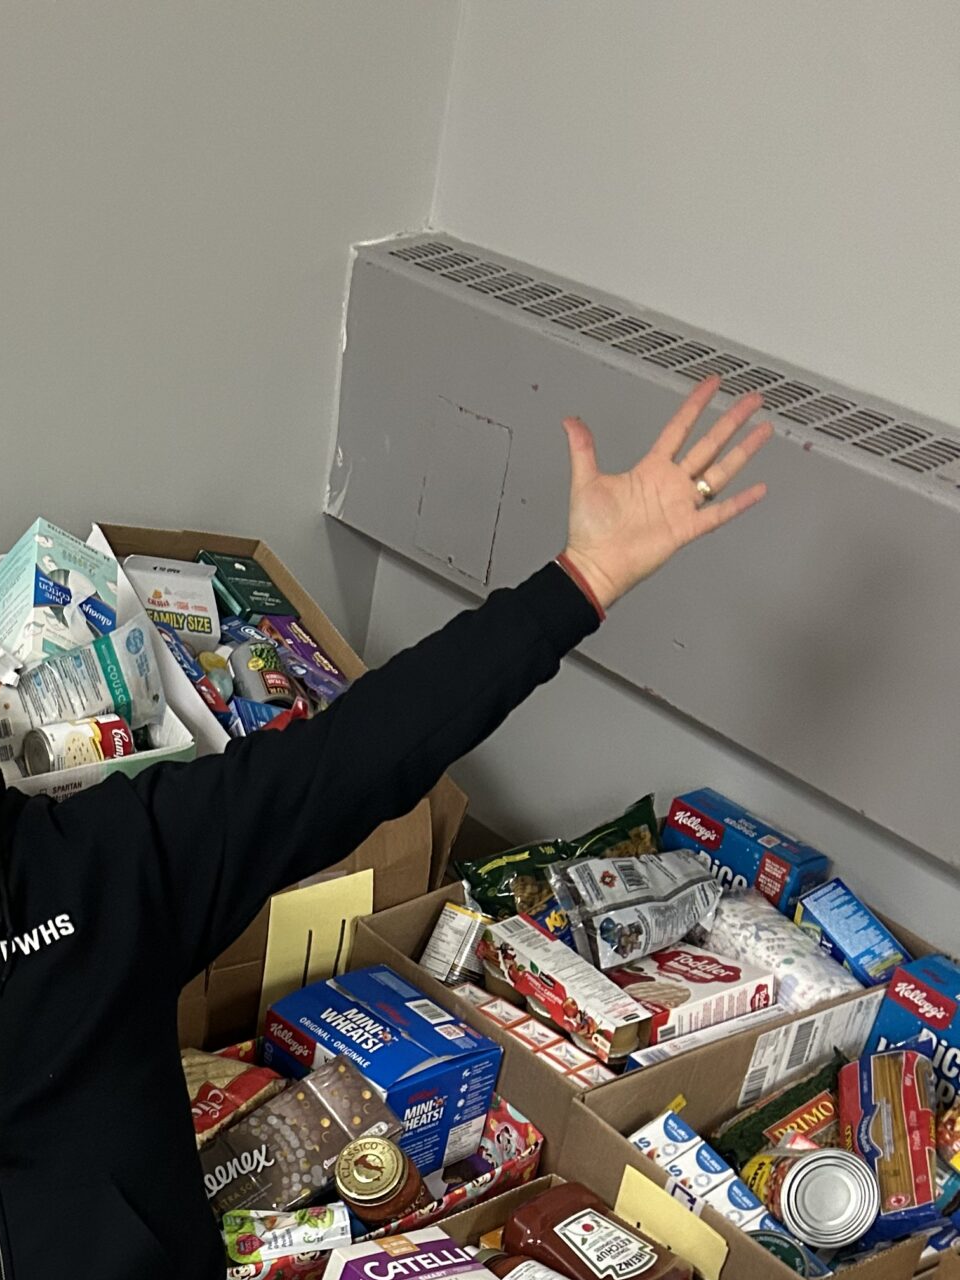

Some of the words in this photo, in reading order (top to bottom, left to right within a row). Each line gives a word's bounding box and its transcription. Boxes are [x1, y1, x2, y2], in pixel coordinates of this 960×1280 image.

[39, 581, 70, 601] cotton
[44, 591, 63, 605] pure
[82, 603, 112, 626] always
[149, 611, 185, 630] FAMILY
[187, 615, 212, 632] SIZE
[52, 781, 83, 794] SPARTAN
[673, 808, 721, 842] Kellogg's
[672, 951, 735, 978] Toddler
[894, 981, 949, 1020] Kellogg's
[269, 1022, 312, 1057] Kellogg's
[299, 1016, 330, 1042] ORIGINAL
[333, 1039, 372, 1069] ORIGINALE
[319, 1007, 385, 1054] WHEATS!
[401, 1107, 444, 1133] HEATS!
[774, 1095, 835, 1144] PRIMO
[204, 1144, 275, 1199] eenex
[340, 1142, 382, 1179] CLASSICO
[596, 1238, 634, 1263] KETCHUP
[617, 1252, 648, 1272] HEINZ
